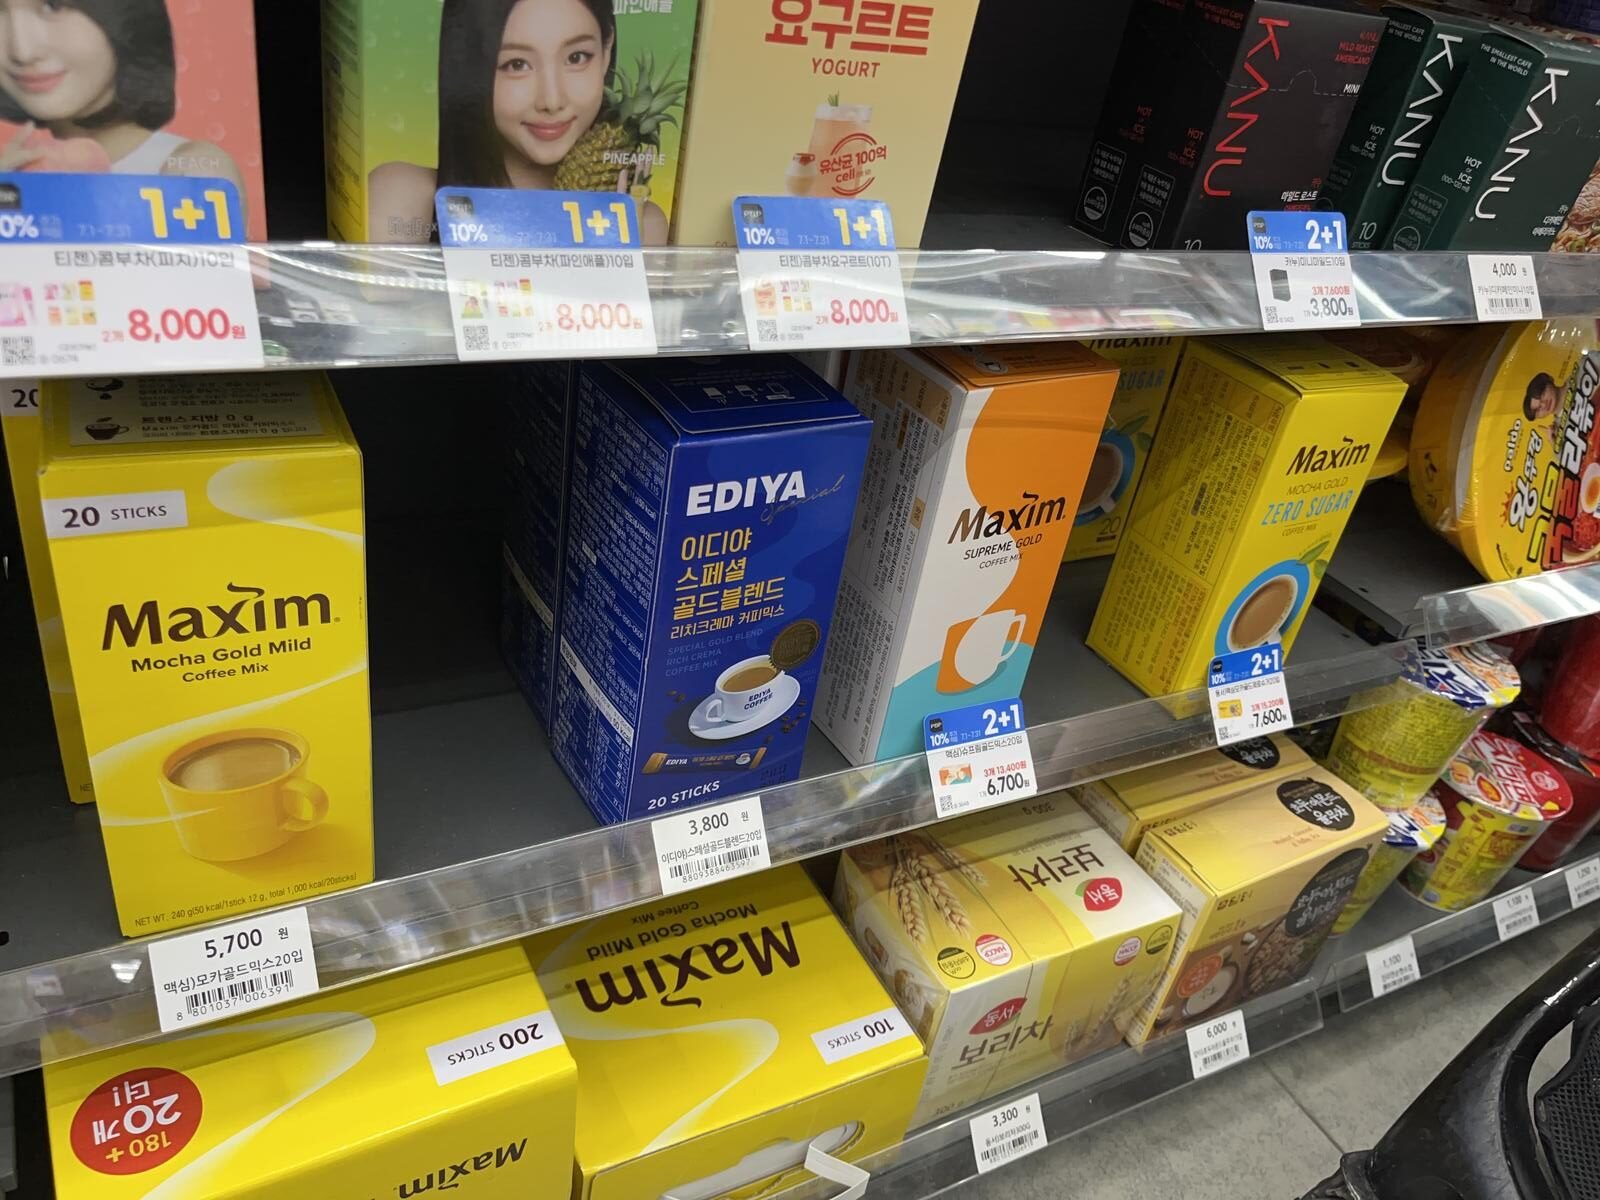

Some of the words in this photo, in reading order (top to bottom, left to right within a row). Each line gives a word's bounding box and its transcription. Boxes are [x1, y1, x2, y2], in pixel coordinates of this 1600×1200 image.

[764, 0, 935, 56] 요구르트
[1412, 26, 1425, 36] CAFE
[811, 58, 881, 79] YOGURT
[1481, 43, 1490, 53] THE
[1491, 47, 1518, 62] SMALLEST
[1517, 56, 1533, 69] CAFE
[1490, 56, 1496, 64] IN
[1497, 59, 1507, 69] THE
[1507, 62, 1529, 76] WORLD
[1343, 84, 1360, 94] MINI
[1203, 16, 1290, 197] KANU
[1382, 33, 1464, 186] KANU
[1187, 128, 1204, 140] HOT
[1369, 123, 1385, 136] HOT
[1183, 147, 1197, 160] ICE
[1364, 140, 1377, 152] ICE
[1475, 67, 1570, 220] KANU
[167, 157, 220, 169] PEACH
[603, 151, 666, 167] PINEAPPLE
[820, 155, 854, 175] 유산균
[855, 145, 887, 167] 100억
[1464, 155, 1482, 169] HOT
[835, 168, 856, 184] cell
[1458, 172, 1472, 185] ICE
[139, 187, 233, 239] 1+1
[562, 201, 630, 244] 1+1
[449, 223, 488, 242] 10%
[743, 226, 775, 246] 10%
[833, 207, 888, 247] 1+1
[1305, 219, 1343, 250] 2+1
[1359, 221, 1377, 241] 10
[1254, 236, 1273, 249] 10%
[1493, 263, 1517, 278] 4,000
[1118, 368, 1164, 391] SUGAR
[1285, 435, 1370, 476] Maxim
[1504, 418, 1521, 473] paldo
[1287, 481, 1322, 496] MOCHA
[1323, 476, 1348, 490] GOLD
[1508, 429, 1543, 532] 왕뚜껑
[686, 470, 806, 517] EDIYA
[62, 507, 100, 529] 20
[111, 505, 168, 521] STICKS
[947, 491, 1067, 545] Maxim
[1262, 500, 1304, 526] ZERO
[1305, 489, 1354, 518] SUGAR
[1100, 516, 1121, 535] 20
[1281, 525, 1304, 537] COFFEE
[680, 527, 753, 561] 이디야
[963, 541, 1012, 560] SUPREME
[1015, 533, 1042, 550] GOLD
[979, 556, 1008, 569] COFFEE
[1009, 552, 1024, 563] MIX
[675, 557, 748, 591] 스페셜
[672, 577, 786, 621] 골드블렌드
[102, 582, 337, 651] Maxim
[670, 615, 735, 640] 리치크레마
[738, 605, 785, 624] 커피믹스
[667, 640, 706, 655] SPECIAL
[709, 635, 735, 647] GOLD
[735, 628, 763, 641] BLEND
[131, 652, 206, 672] Mocha
[212, 643, 261, 662] Gold
[268, 637, 312, 655] Mild
[666, 653, 689, 666] RICH
[691, 648, 722, 661] CREMA
[1251, 649, 1279, 676] 2+1
[182, 666, 237, 683] Coffee
[241, 662, 269, 675] Mix
[665, 664, 701, 677] COFFEE
[702, 659, 718, 670] MIX
[1211, 673, 1226, 685] 10%
[744, 693, 773, 710] COFFEE
[748, 688, 771, 702] EDIYA
[982, 704, 1020, 736] 2+1
[930, 732, 949, 747] 10%
[647, 796, 667, 810] 20
[671, 781, 720, 804] STICKS
[688, 812, 729, 836] 3,800
[741, 811, 749, 822] 원
[1313, 805, 1349, 826] 율무차
[661, 829, 762, 863] 이디야)스페셜골드블렌드20입
[1008, 843, 1105, 893] 보리차
[135, 915, 152, 927] NET
[171, 909, 186, 920] 240
[269, 887, 286, 899] total
[286, 884, 307, 897] 1,000
[1093, 883, 1119, 906] 동서
[631, 912, 655, 924] Mix
[663, 900, 699, 917] Coffee
[695, 903, 758, 929] Mocha
[205, 928, 263, 959] 5,700
[277, 927, 289, 940] 원
[641, 922, 687, 947] Gold
[586, 937, 634, 962] Mild
[985, 945, 1007, 958] HACCP
[163, 948, 304, 994] 맥심)모카골드믹스20입
[575, 921, 801, 1014] Maxim
[176, 1011, 184, 1021] 8
[193, 998, 238, 1017] 801037
[245, 984, 289, 1004] 006391
[863, 1017, 894, 1039] 100
[984, 1005, 1014, 1028] 동서
[499, 1023, 544, 1050] 200
[827, 1031, 862, 1051] STICKS
[1206, 1022, 1227, 1038] 6,000
[447, 1042, 495, 1066] STICKS
[951, 1015, 1054, 1071] 보리차
[112, 1081, 151, 1107] 더!
[92, 1093, 182, 1146] 20개
[992, 1107, 1019, 1127] 3,300
[396, 1138, 528, 1199] Maxim
